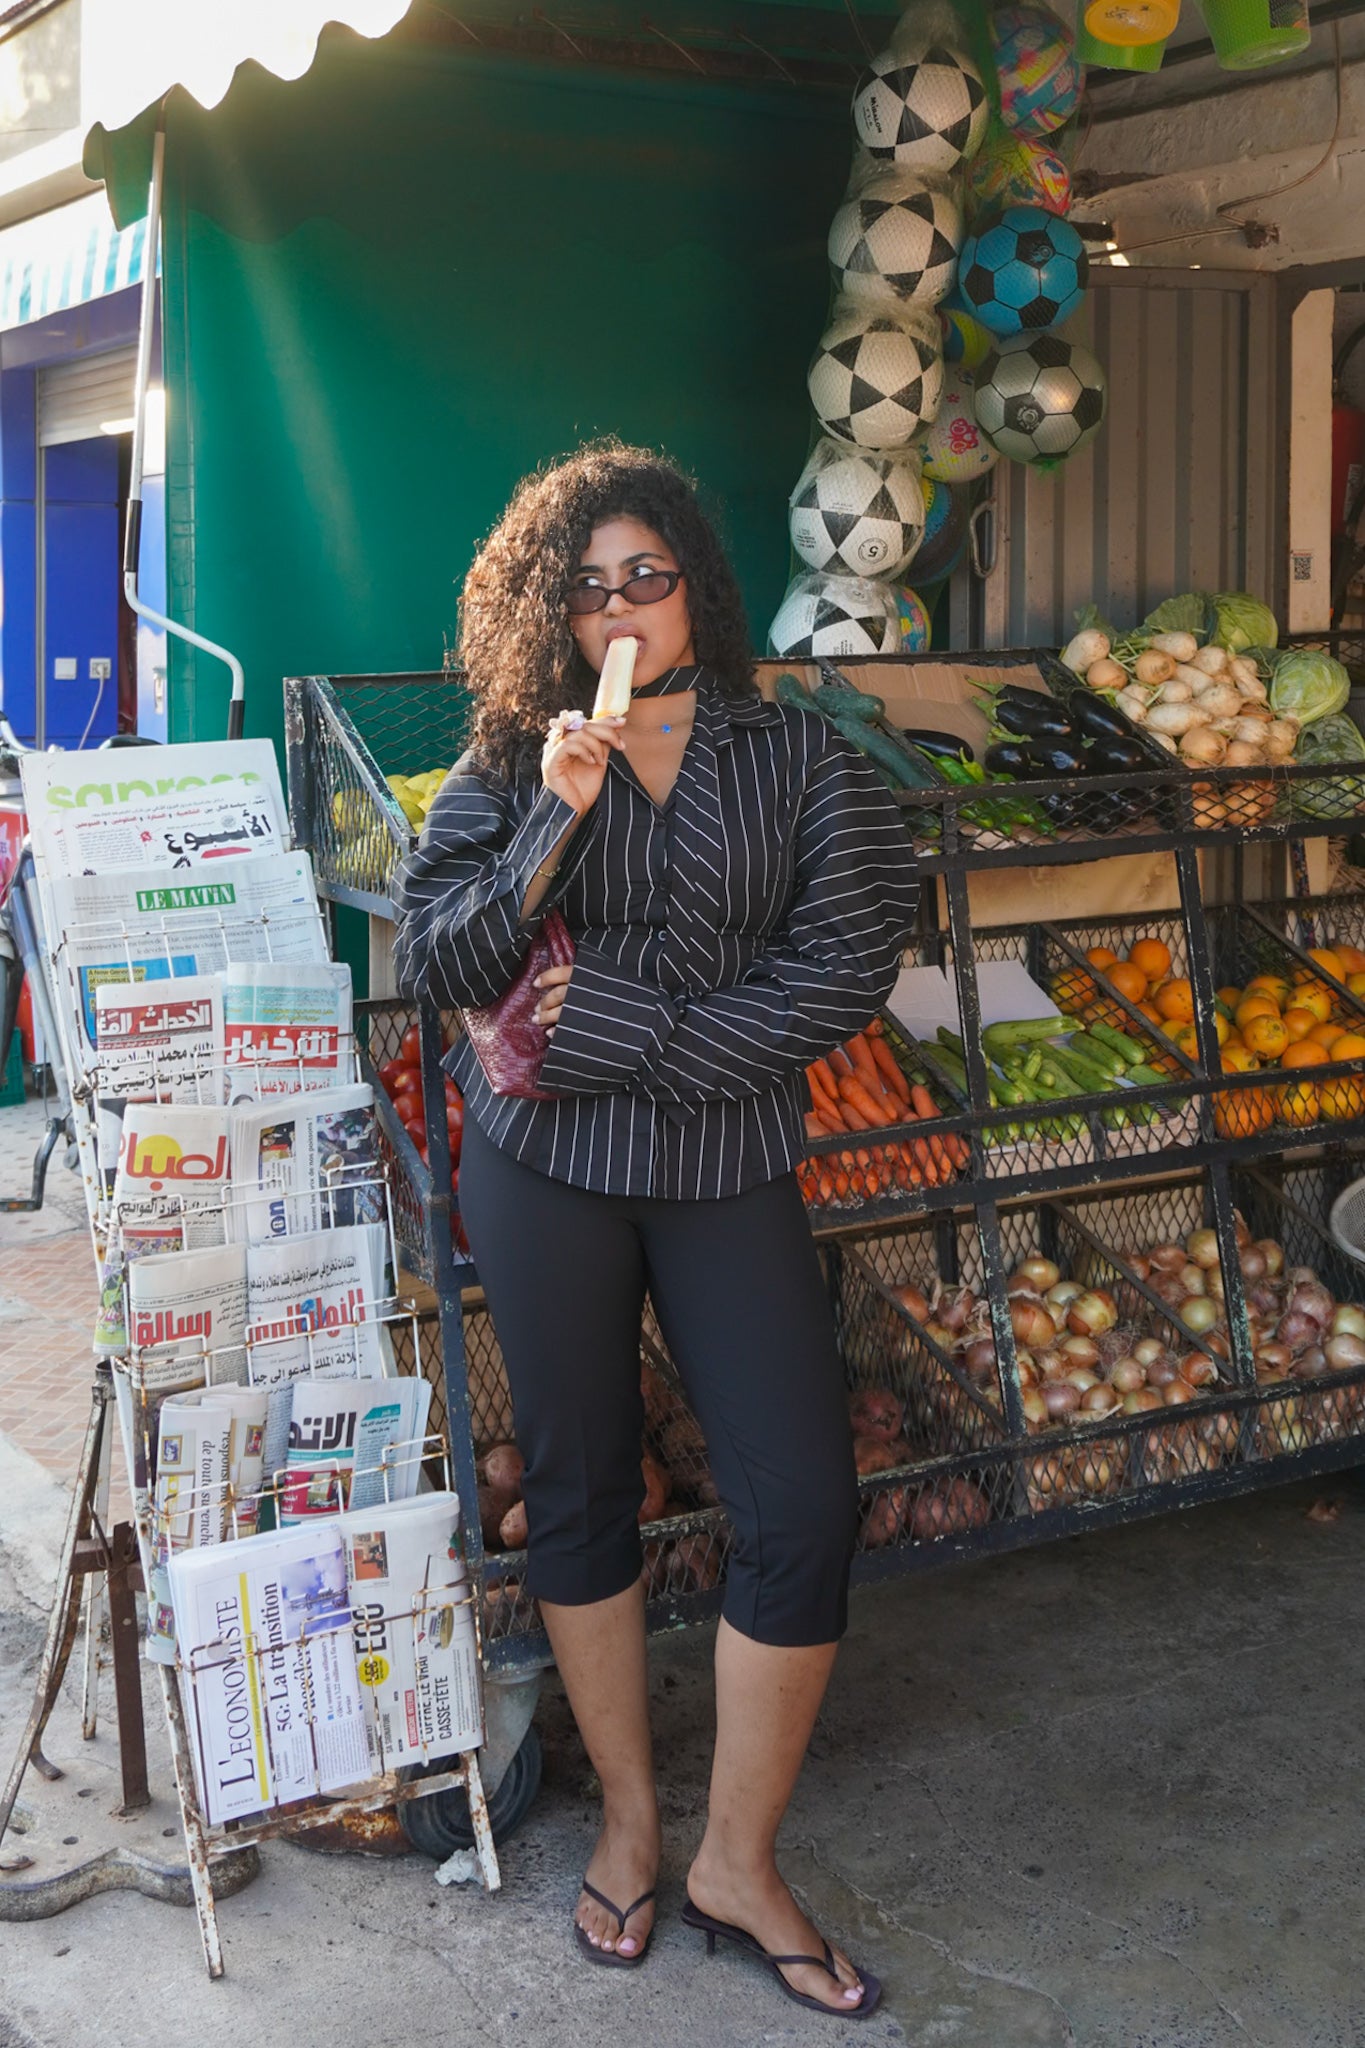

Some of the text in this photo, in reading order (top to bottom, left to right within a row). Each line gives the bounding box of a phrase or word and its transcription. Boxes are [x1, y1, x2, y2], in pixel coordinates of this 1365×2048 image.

[867, 545, 878, 558] 5
[164, 809, 272, 854] الأسبوع
[140, 891, 167, 911] LE
[170, 885, 233, 908] MATIN
[137, 1310, 212, 1346] رسالة
[202, 1440, 215, 1455] de
[352, 1603, 387, 1654] ECO
[216, 1596, 256, 1791] L'ECONOMISTE
[270, 1674, 289, 1701] La
[275, 1703, 292, 1732] 5G:
[434, 1675, 452, 1741] CASSE-TÊTE
[382, 1713, 393, 1745] SIGNATURE
